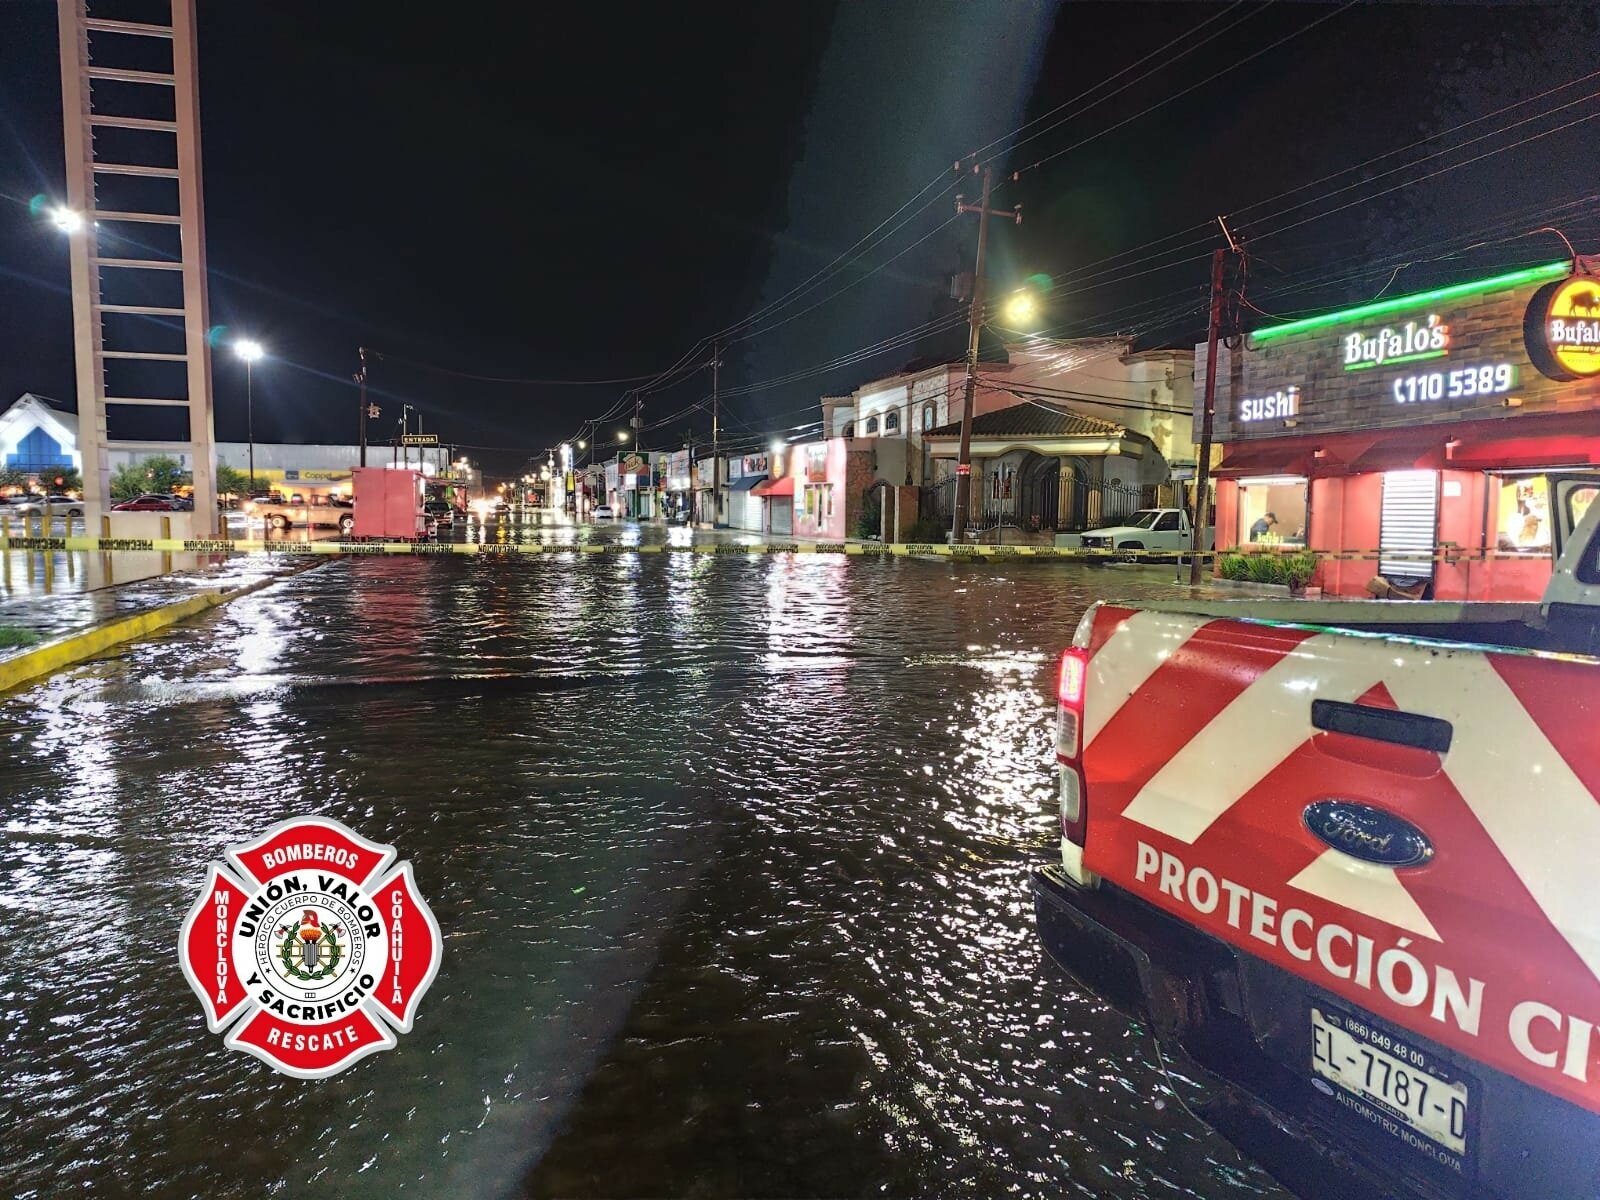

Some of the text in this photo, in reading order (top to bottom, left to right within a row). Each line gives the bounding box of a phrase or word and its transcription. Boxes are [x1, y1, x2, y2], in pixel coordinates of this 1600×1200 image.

[1344, 314, 1447, 365] Bufalo's
[1551, 319, 1600, 345] Bufal
[1240, 386, 1296, 422] sushi
[1406, 364, 1512, 401] 110 5389
[1323, 810, 1395, 854] Ford
[1135, 841, 1600, 1084] PROTECCIÓN CI
[1345, 1017, 1425, 1067] (866) 649 48 00
[1313, 1023, 1466, 1139] EL-7787-D
[1335, 1091, 1399, 1136] AUTOMOTRIZ
